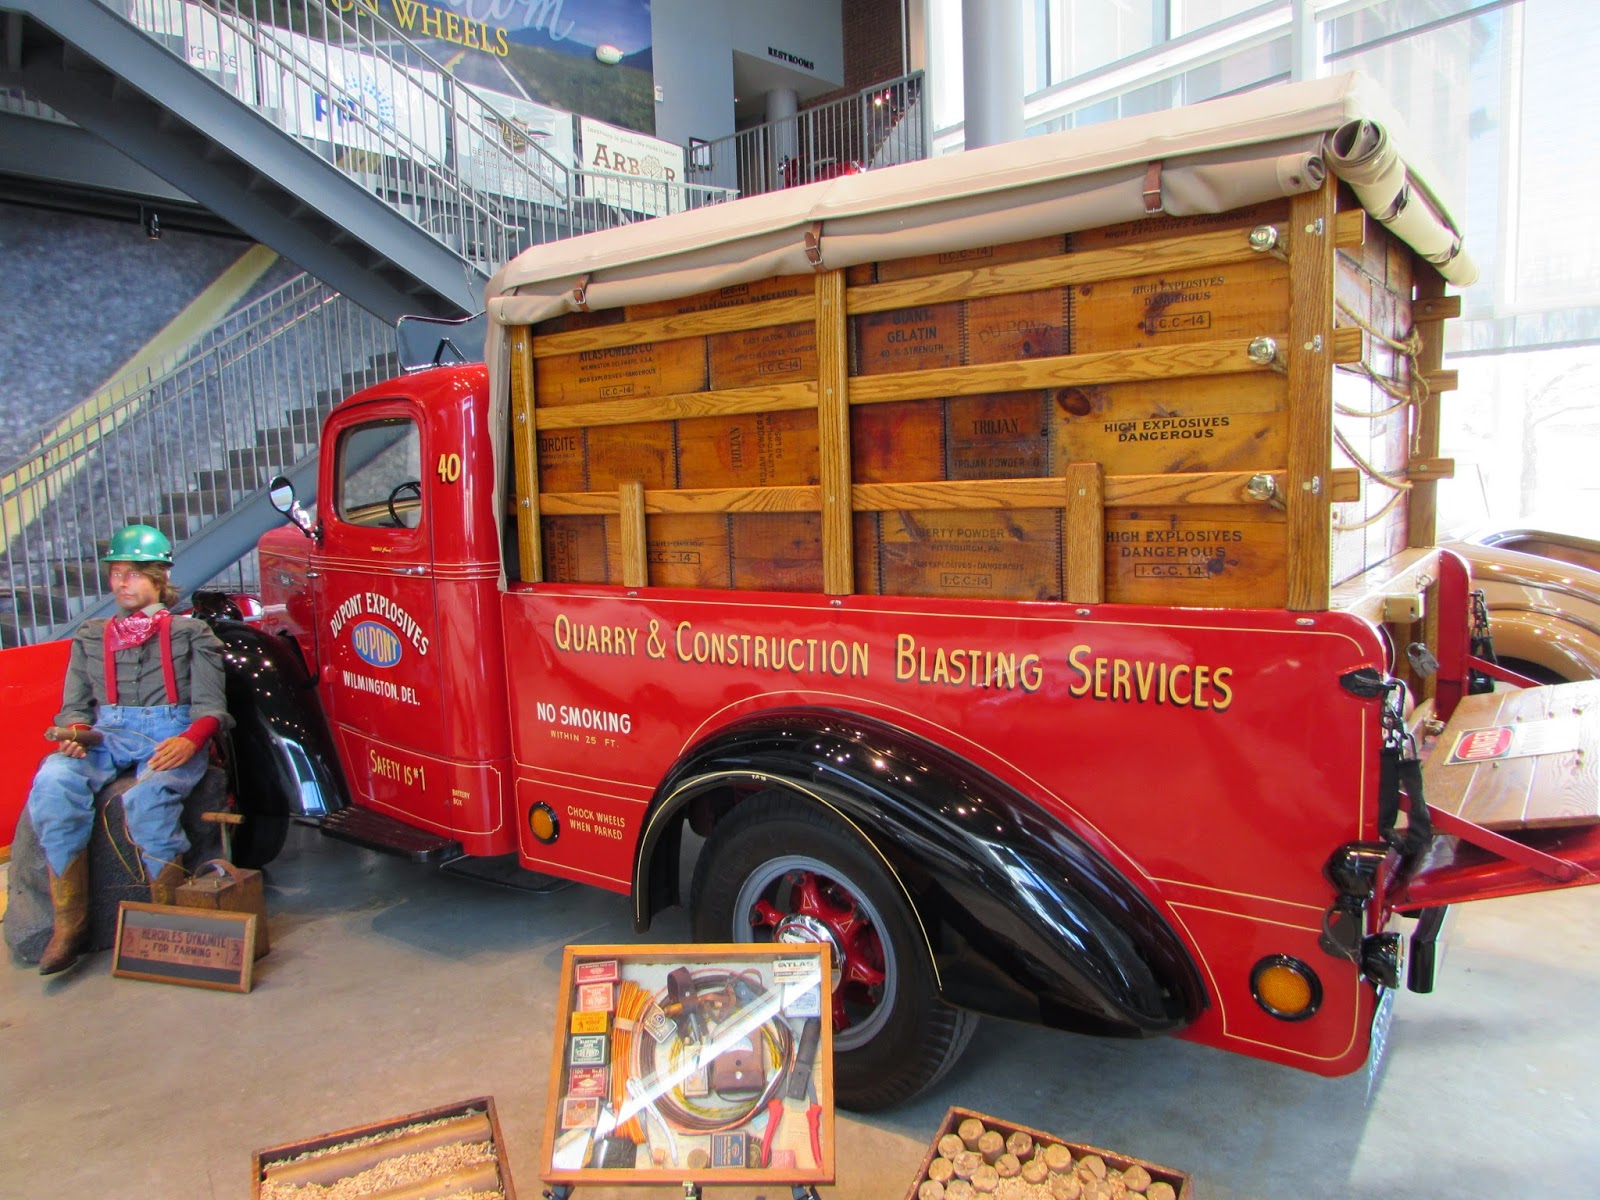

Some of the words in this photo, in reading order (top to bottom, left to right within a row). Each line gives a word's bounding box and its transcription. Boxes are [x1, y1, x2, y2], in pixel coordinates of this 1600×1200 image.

[391, 0, 509, 57] WHEELS
[768, 46, 814, 70] RESTROOMS
[1132, 283, 1158, 295] HIGH
[1160, 276, 1225, 293] EXPLOSIVES
[1144, 290, 1212, 307] DANGEROUS
[888, 326, 937, 344] GELATIN
[579, 350, 603, 363] ATLAS
[903, 344, 944, 357] STRENGTH
[972, 418, 1019, 435] TROJAN
[1104, 421, 1137, 433] HIGH
[1143, 416, 1230, 431] EXPLOSIVES
[540, 436, 576, 452] ORCITE
[757, 420, 765, 454] POWDER
[1118, 428, 1214, 443] DANGEROUS
[730, 427, 742, 470] TROJAN
[437, 453, 461, 482] 40
[954, 458, 986, 469] TROJAN
[989, 457, 1025, 468] POWDER
[957, 528, 1005, 539] POWDER
[1105, 531, 1140, 543] HIGH
[1146, 530, 1243, 543] EXPLOSIVES
[1121, 546, 1226, 559] DANGEROUS
[365, 592, 430, 656] EXPLOSIVES
[553, 613, 638, 656] QUARRY
[647, 618, 666, 660] &
[675, 620, 869, 677] CONSTRUCTION
[895, 632, 1044, 693] BLASTING
[1067, 644, 1234, 711] SERVICES
[401, 685, 421, 706] DEL.
[537, 702, 556, 723] NO
[560, 705, 631, 734] SMOKING
[550, 730, 580, 742] WITHIN
[585, 735, 597, 745] 25
[604, 738, 620, 748] FT.
[369, 749, 400, 781] SAFETY
[403, 764, 414, 786] IS
[453, 798, 462, 806] BOX
[567, 805, 594, 821] CHOCK
[597, 811, 625, 828] WHEELS
[569, 819, 591, 834] WHEN
[594, 824, 623, 840] PARKED
[142, 928, 182, 943] HERCULES
[186, 932, 226, 948] DYNAMITE
[153, 942, 169, 952] FOR
[174, 945, 211, 958] FARMING
